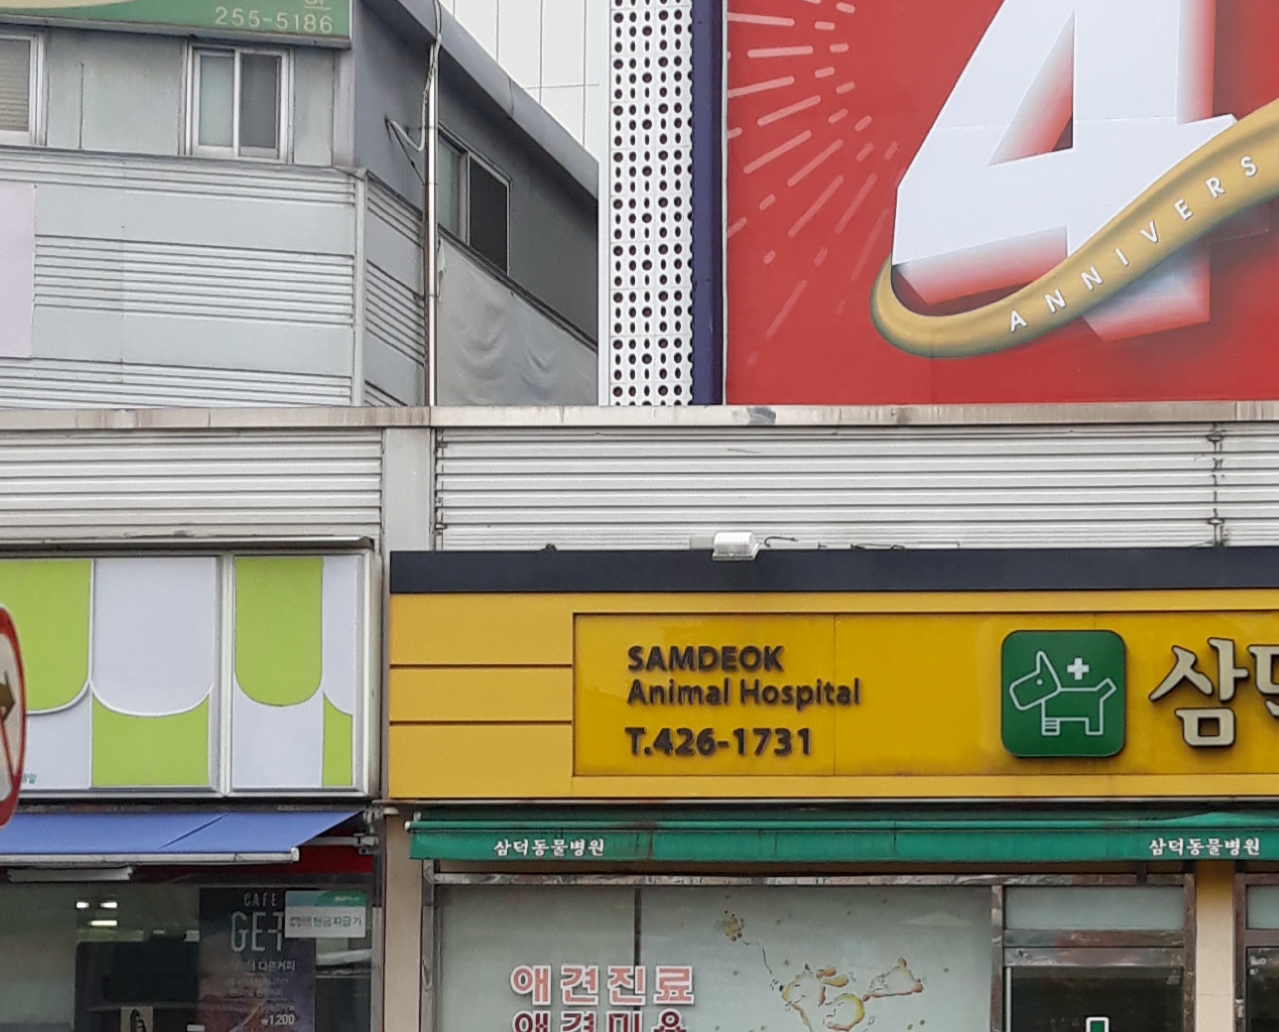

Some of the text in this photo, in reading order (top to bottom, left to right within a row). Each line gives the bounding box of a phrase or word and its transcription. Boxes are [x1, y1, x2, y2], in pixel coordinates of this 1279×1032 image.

[214, 6, 333, 34] 255-5186
[626, 645, 785, 673] SAMDEOK
[626, 677, 862, 712] Animal Hospital
[624, 726, 812, 757] T.426-1731
[493, 837, 606, 857] 삼덕동물병원
[1148, 836, 1261, 857] 삼덕동물병원
[243, 892, 278, 908] CAFE
[510, 965, 695, 1006] 애견진료
